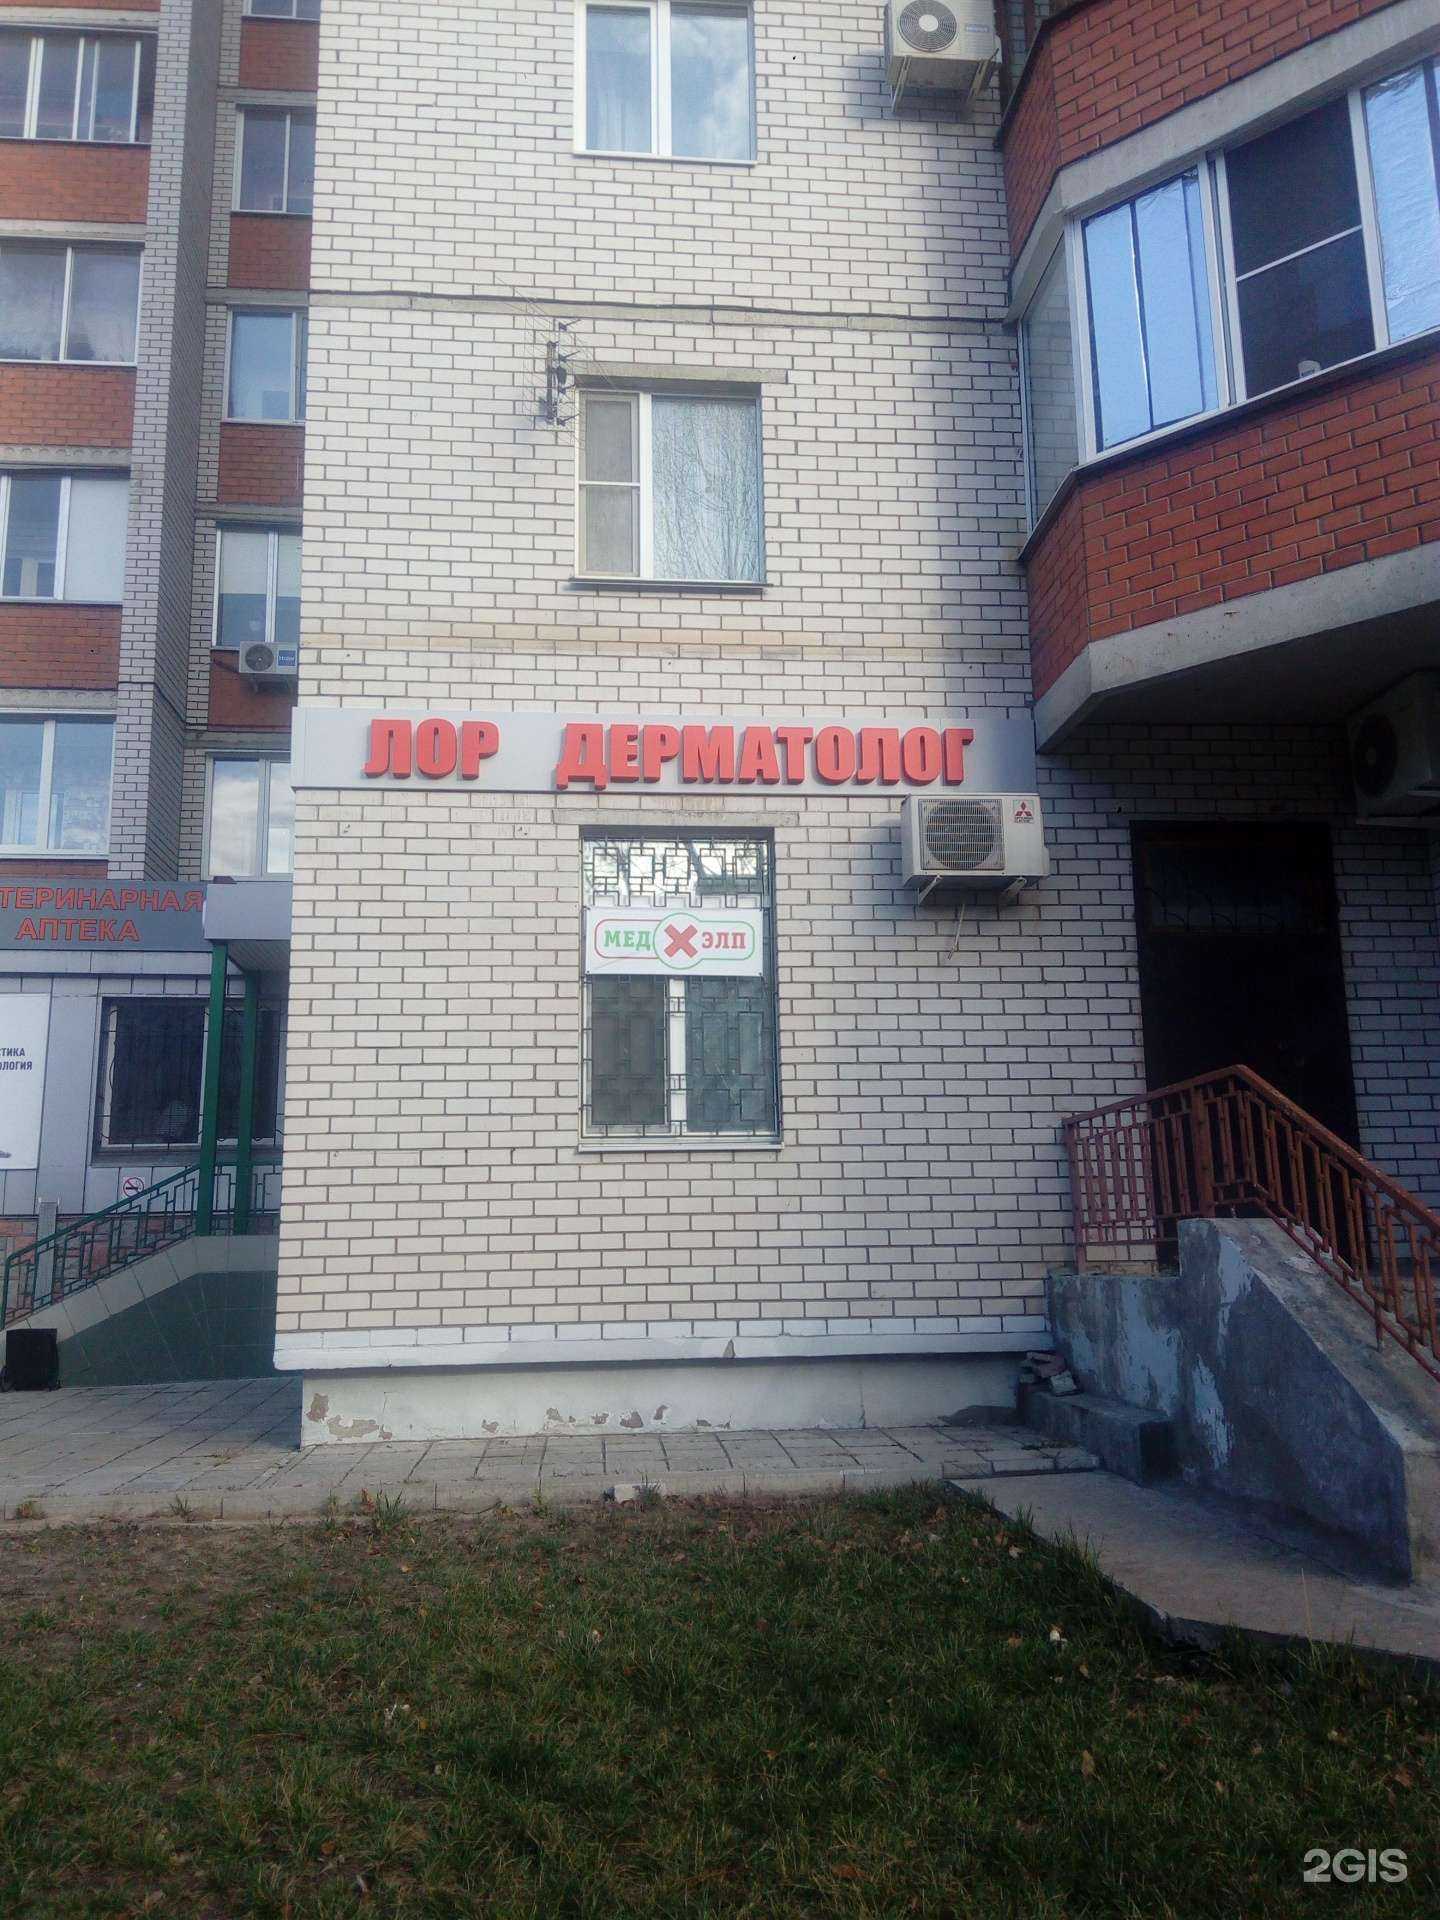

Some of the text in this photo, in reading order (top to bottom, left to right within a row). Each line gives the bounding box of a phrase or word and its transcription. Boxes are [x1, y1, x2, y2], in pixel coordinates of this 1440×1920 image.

[363, 718, 974, 790] ЛОР ДЕРМАТОЛОГ
[15, 918, 140, 942] АПТЕКА
[0, 1047, 26, 1057] ТИКА
